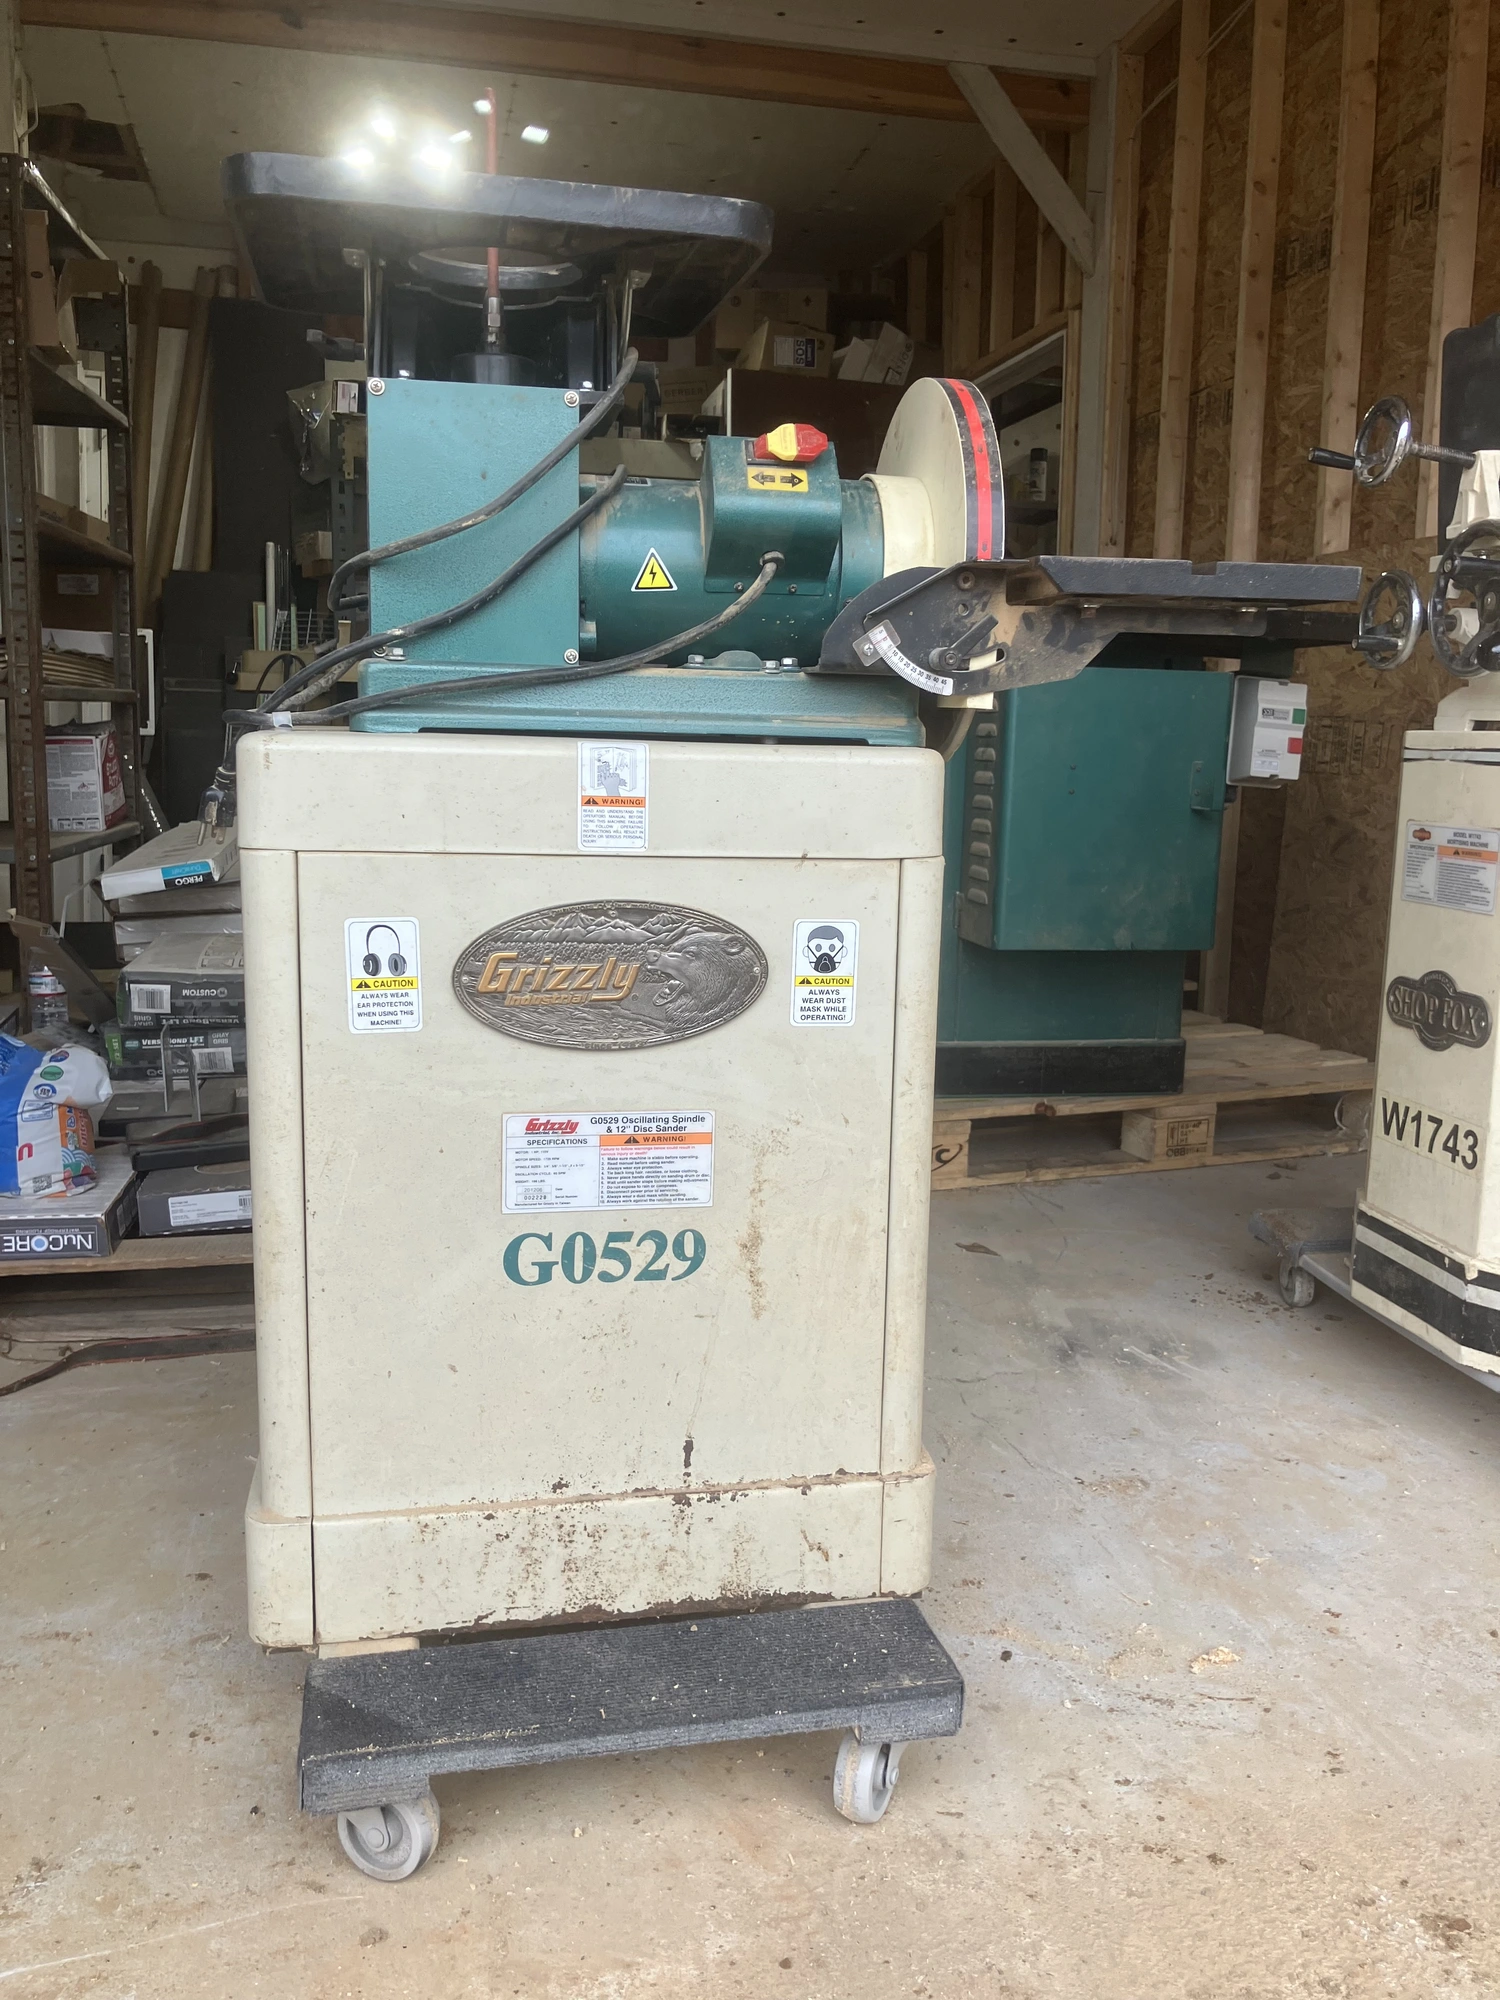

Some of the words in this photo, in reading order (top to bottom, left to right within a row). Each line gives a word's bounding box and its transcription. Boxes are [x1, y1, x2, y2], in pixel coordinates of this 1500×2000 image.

[796, 339, 805, 364] SOS
[175, 875, 204, 886] PERGO
[373, 980, 413, 988] CAUTION
[478, 952, 641, 1002] Grizzly
[504, 992, 590, 1006] Industrial
[1392, 986, 1438, 1024] SHOP
[1442, 998, 1480, 1038] FOX
[525, 1118, 579, 1134] Grizzly
[590, 1116, 619, 1125] G0529
[622, 1116, 669, 1125] Oscillating
[672, 1115, 706, 1124] Spindle
[1382, 1097, 1478, 1170] W1743
[3, 1234, 92, 1252] NuCORE
[503, 1229, 706, 1287] G0529
